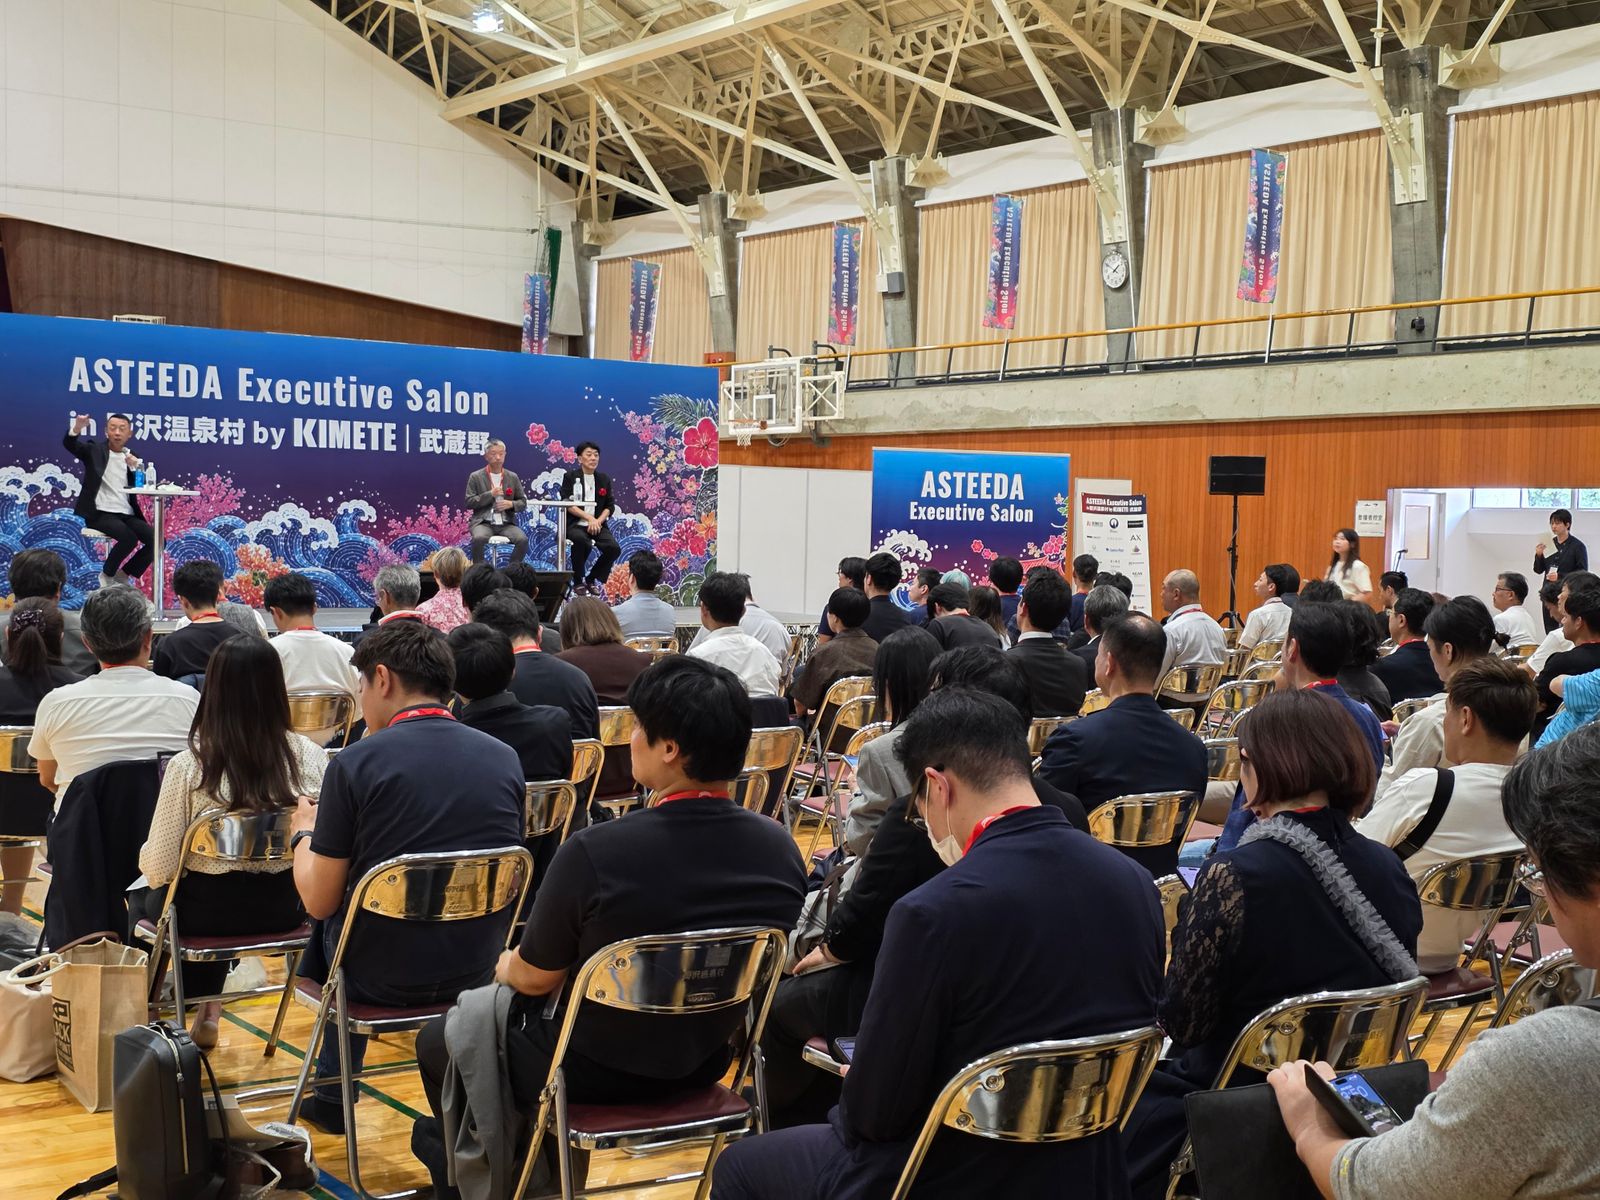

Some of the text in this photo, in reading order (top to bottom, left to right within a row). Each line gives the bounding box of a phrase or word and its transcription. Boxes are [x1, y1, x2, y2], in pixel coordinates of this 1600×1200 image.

[68, 356, 489, 415] ASTEEDA Executive Salon
[106, 412, 246, 445] 沢温泉村
[253, 421, 286, 450] by
[293, 417, 397, 451] KIMETE
[419, 428, 490, 456] 武蔵野
[921, 470, 1024, 501] ASTEEDA
[909, 501, 1034, 523] Executive Salon
